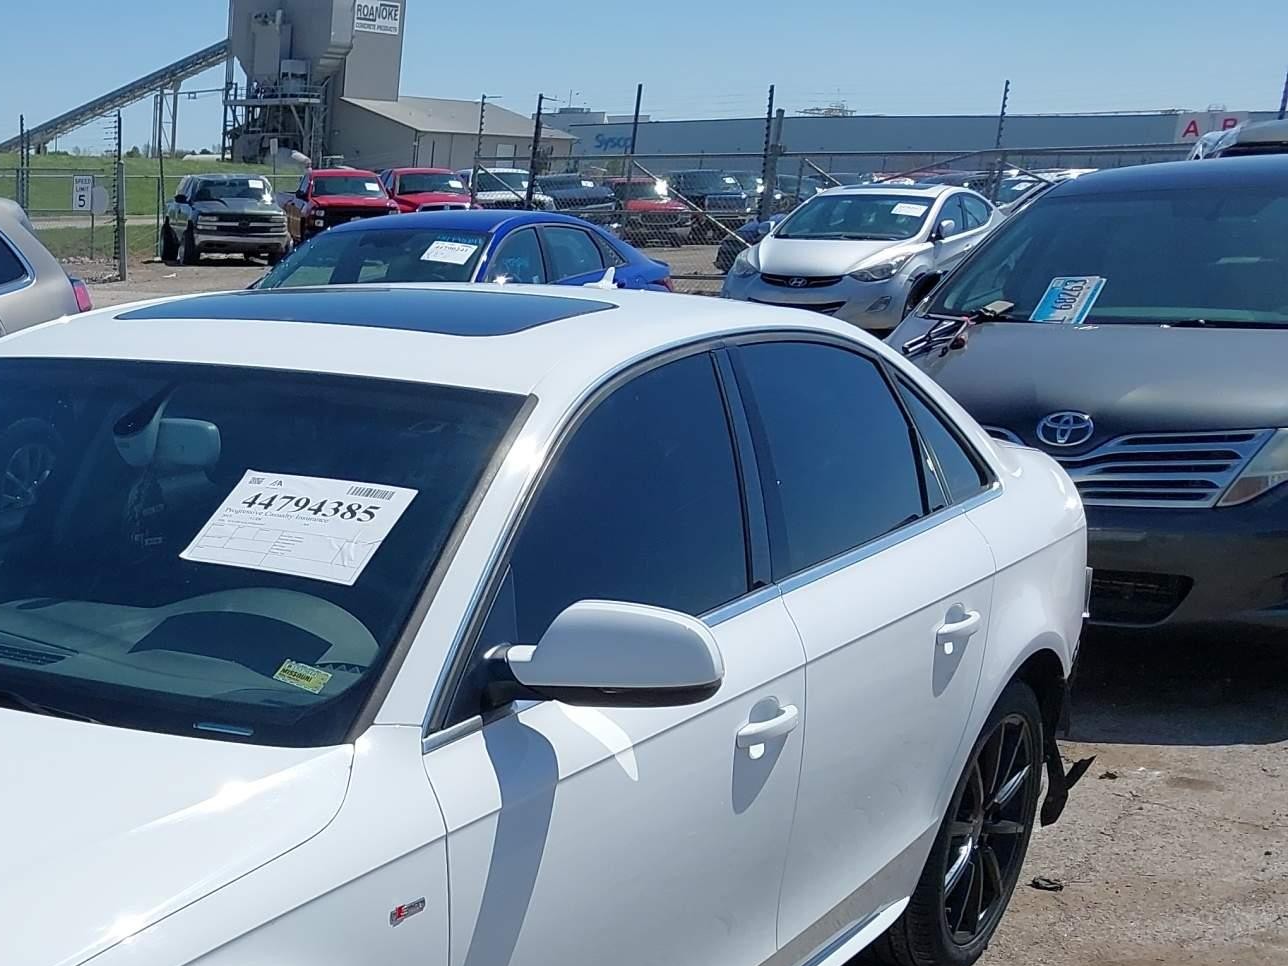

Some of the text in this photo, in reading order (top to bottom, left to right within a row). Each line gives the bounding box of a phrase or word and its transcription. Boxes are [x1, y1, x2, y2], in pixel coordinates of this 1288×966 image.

[357, 4, 398, 21] ROANOKE
[78, 194, 86, 208] 5
[224, 506, 263, 517] Progressive
[264, 510, 294, 520] Casualty
[295, 513, 329, 524] Insurance
[242, 493, 381, 523] 44794385
